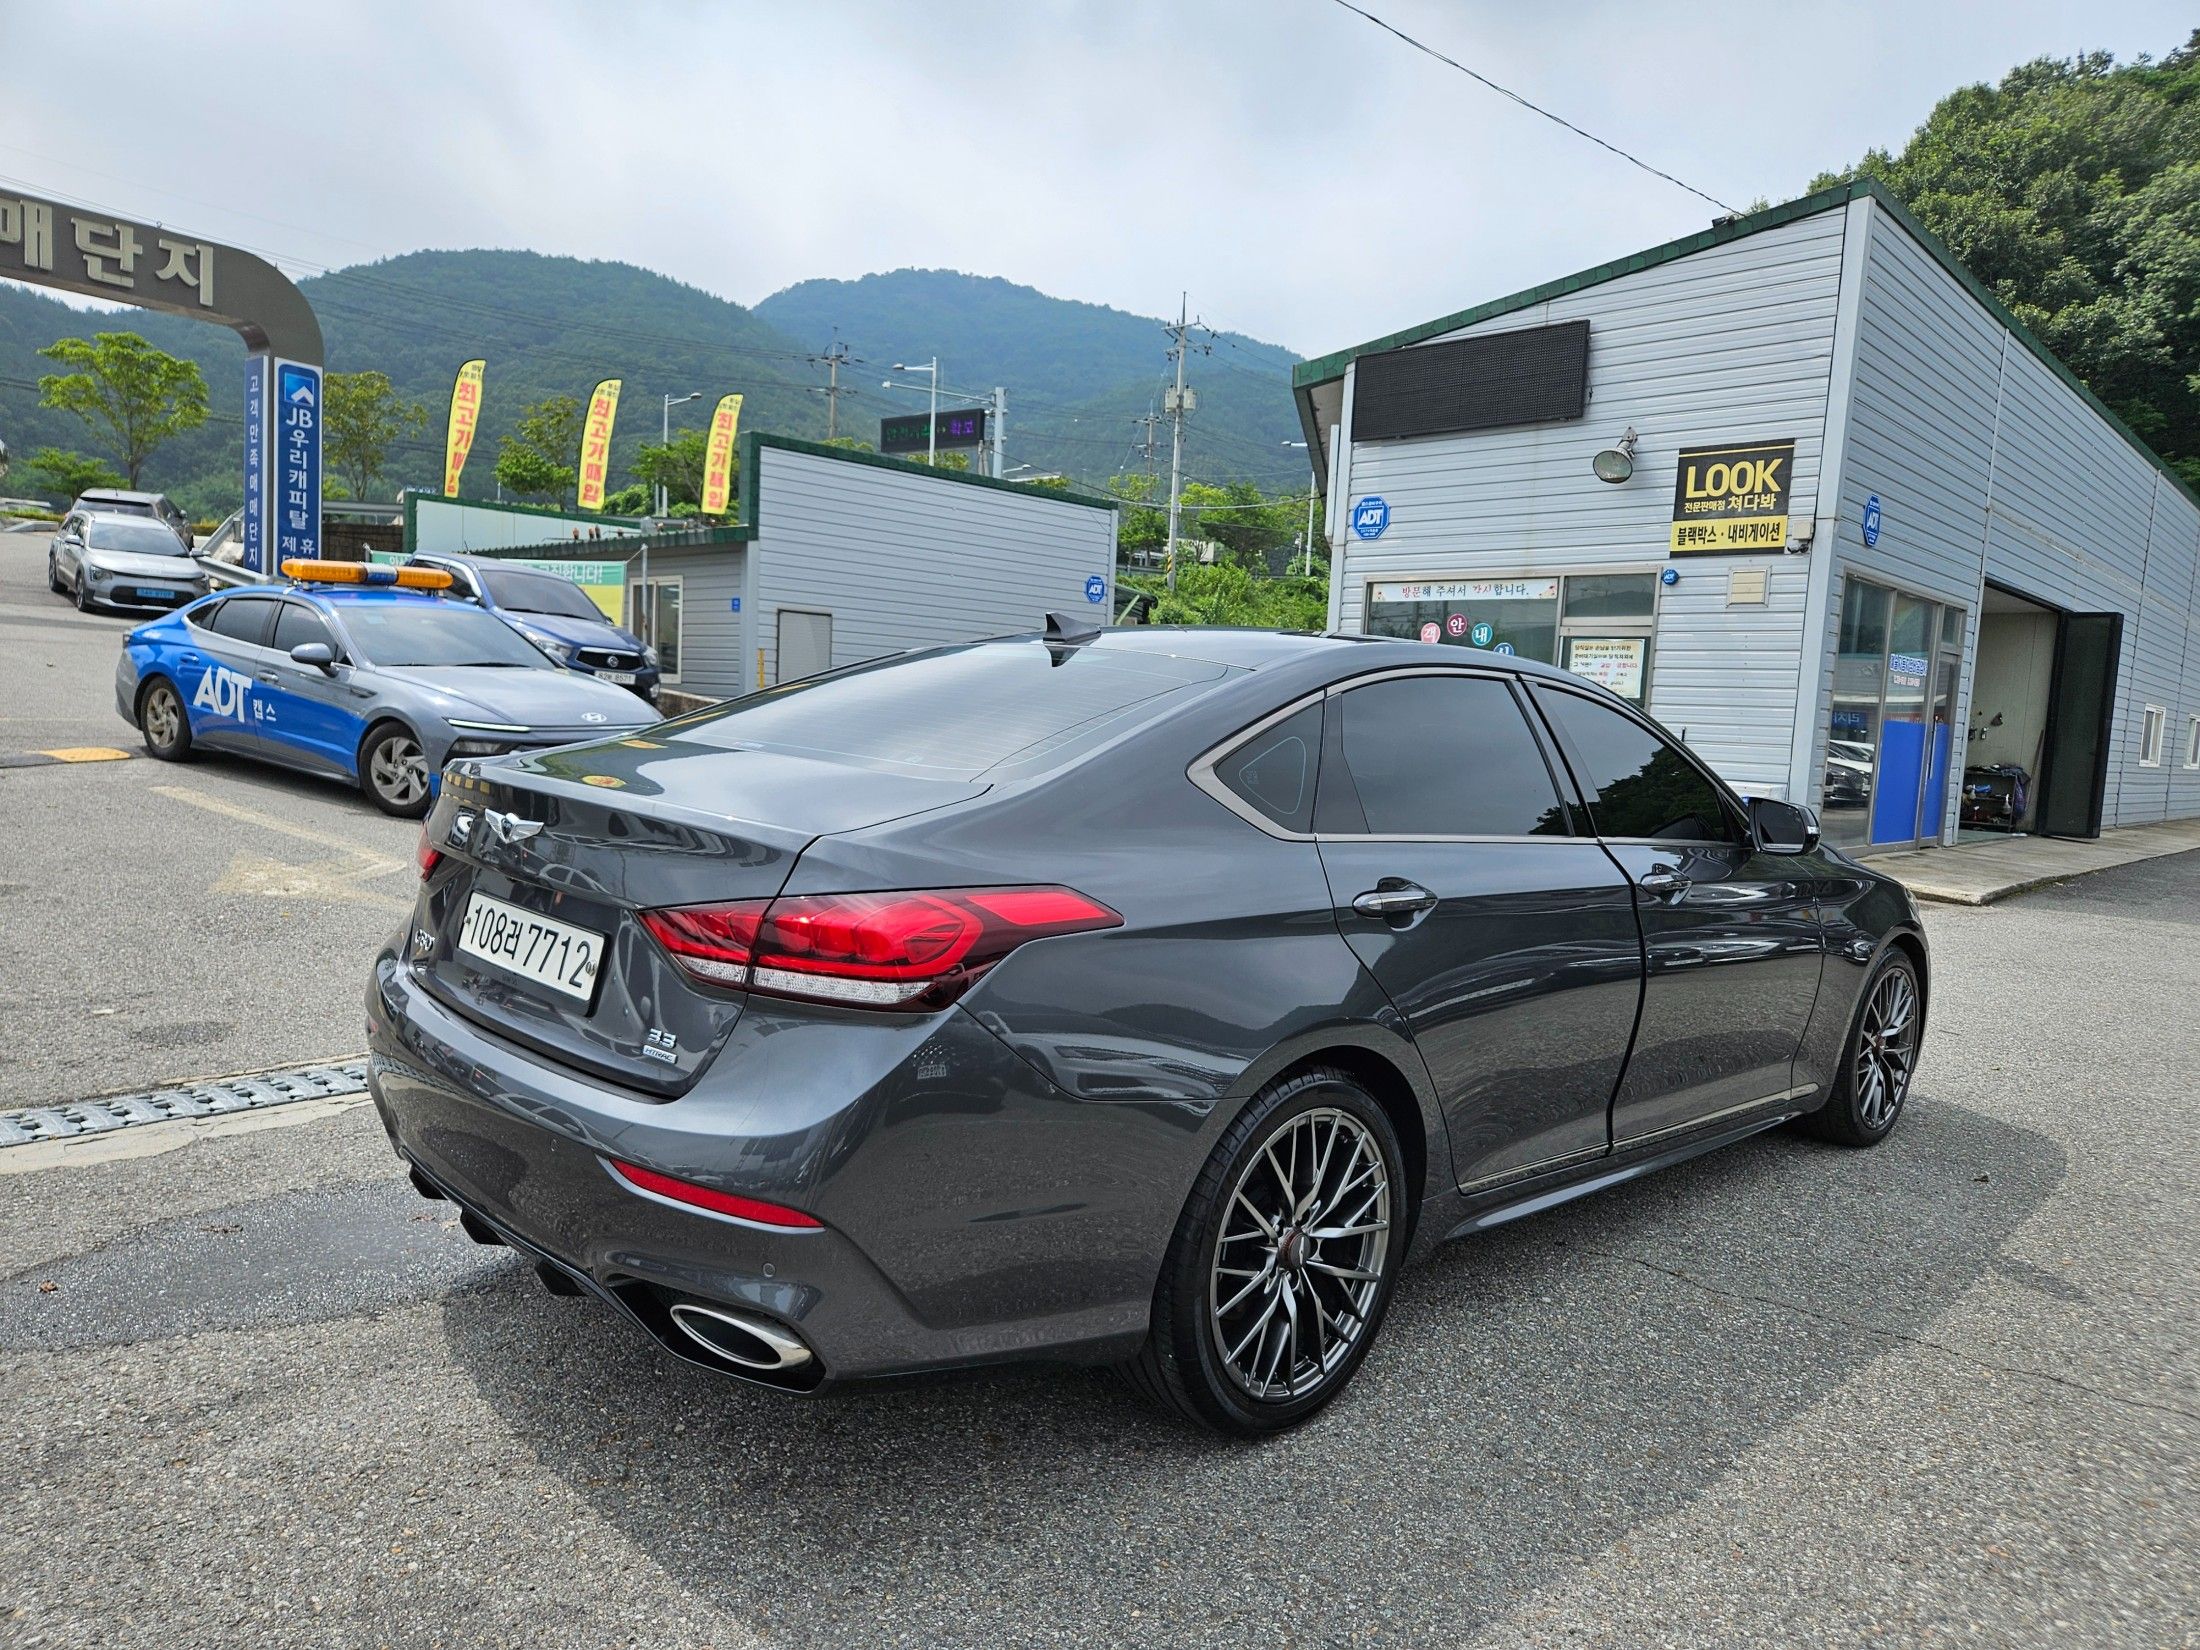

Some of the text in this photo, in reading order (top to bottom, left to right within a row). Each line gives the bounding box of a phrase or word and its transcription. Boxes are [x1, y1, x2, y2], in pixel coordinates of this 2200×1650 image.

[582, 397, 612, 503] 최고가매입
[1685, 457, 1784, 499] LOOK
[1684, 492, 1777, 513] 전문판매점 쳐다봐
[1358, 509, 1384, 525] ADT
[1867, 511, 1880, 531] ADT
[1677, 522, 1781, 546] 블랙박스 내비게이션
[282, 536, 315, 555] 제휴
[1089, 584, 1103, 595] ADT
[1402, 586, 1431, 598] 방문해
[1436, 584, 1467, 597] 주셔서
[193, 664, 277, 723] ADT 캡스
[522, 923, 591, 989] 7712
